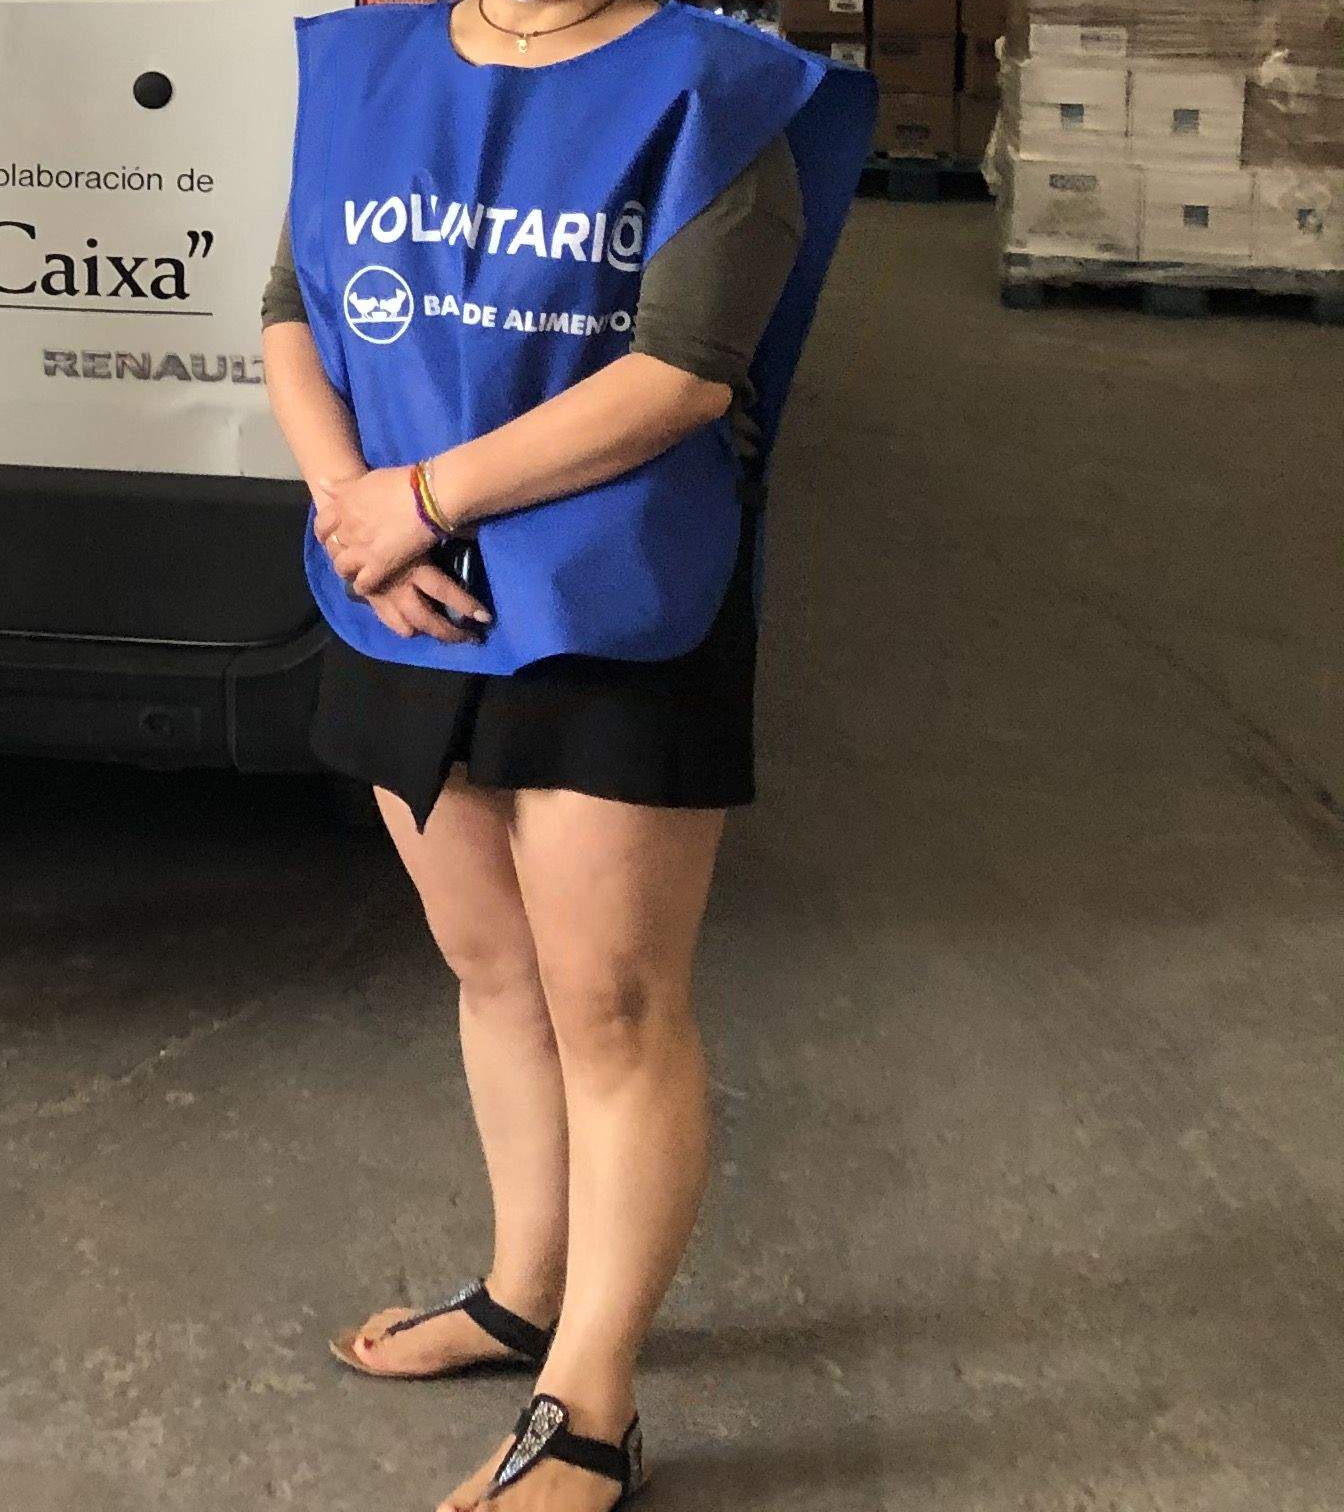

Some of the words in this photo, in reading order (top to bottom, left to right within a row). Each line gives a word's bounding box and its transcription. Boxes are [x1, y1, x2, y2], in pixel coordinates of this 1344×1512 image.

[176, 168, 215, 193] de
[462, 302, 498, 329] DE
[503, 309, 636, 336] ALIMENO
